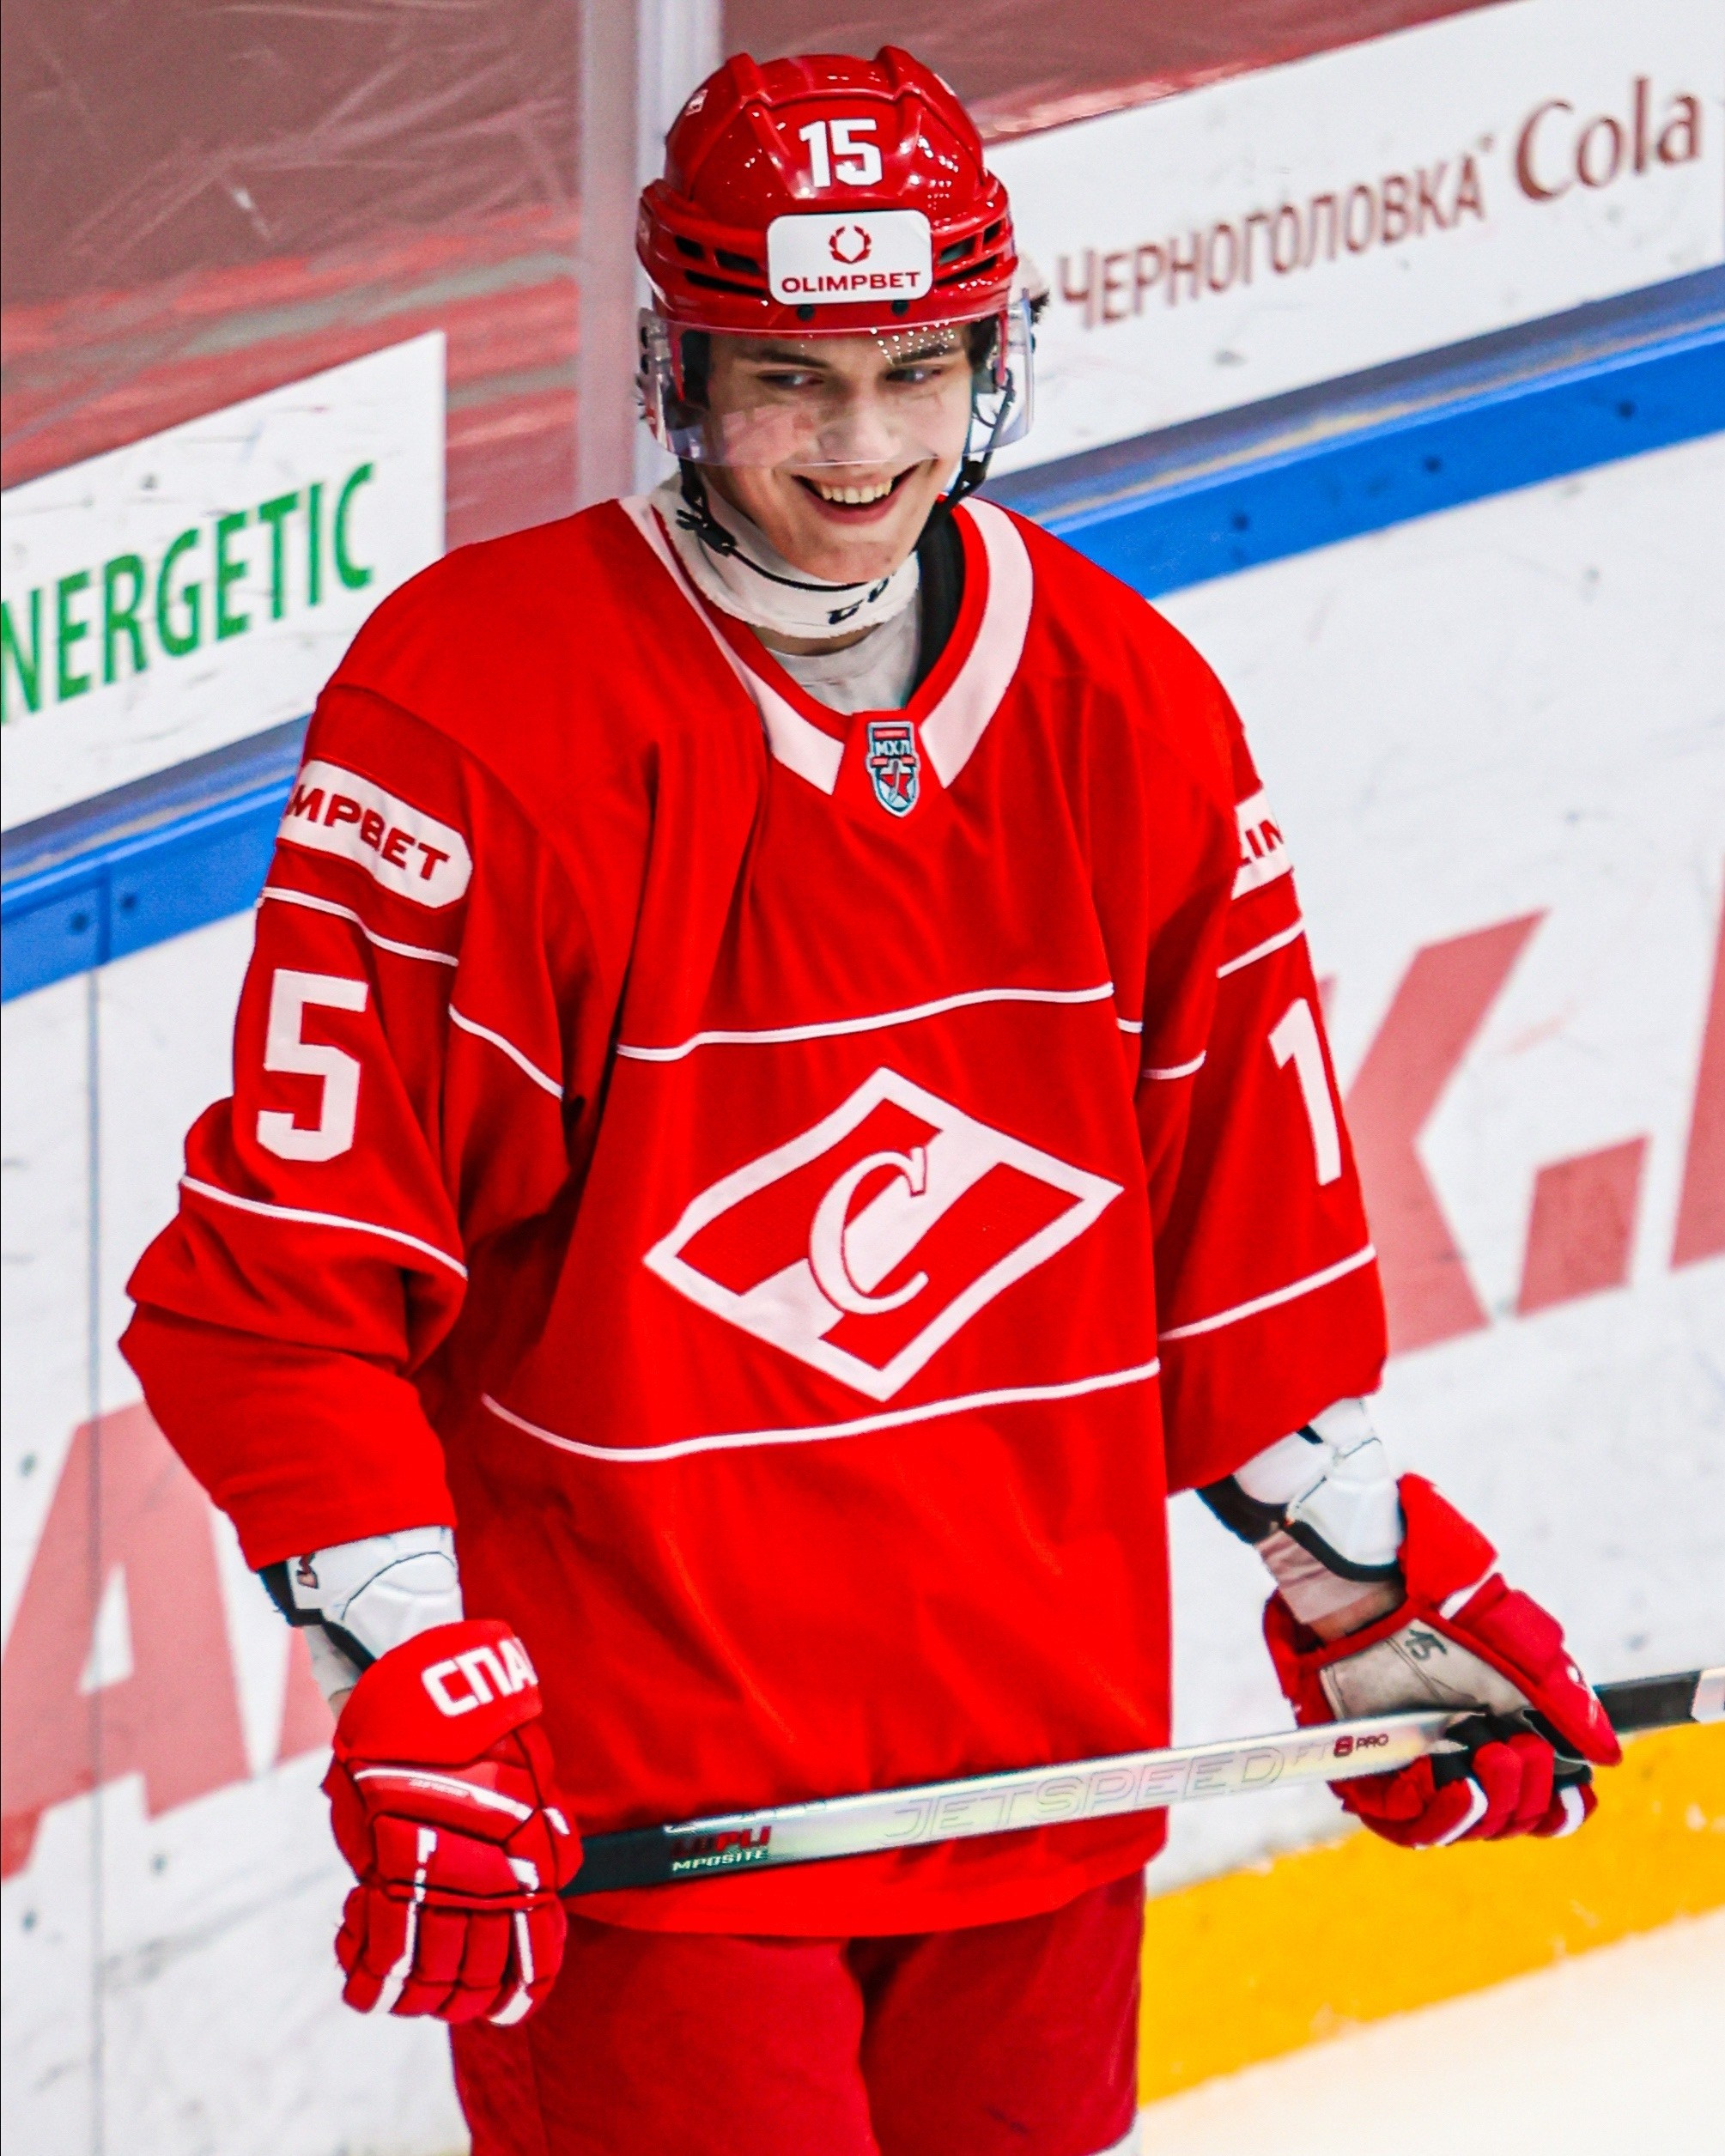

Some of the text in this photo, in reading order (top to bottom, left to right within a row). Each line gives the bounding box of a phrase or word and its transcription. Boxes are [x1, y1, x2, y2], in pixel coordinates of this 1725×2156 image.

[799, 118, 883, 188] 15
[1057, 76, 1703, 330] ЧЕРНОГОЛОВКА Cola
[781, 270, 921, 294] OLIMPBET
[879, 1746, 1286, 1843] JETSPEED
[1356, 1734, 1390, 1751] PRO
